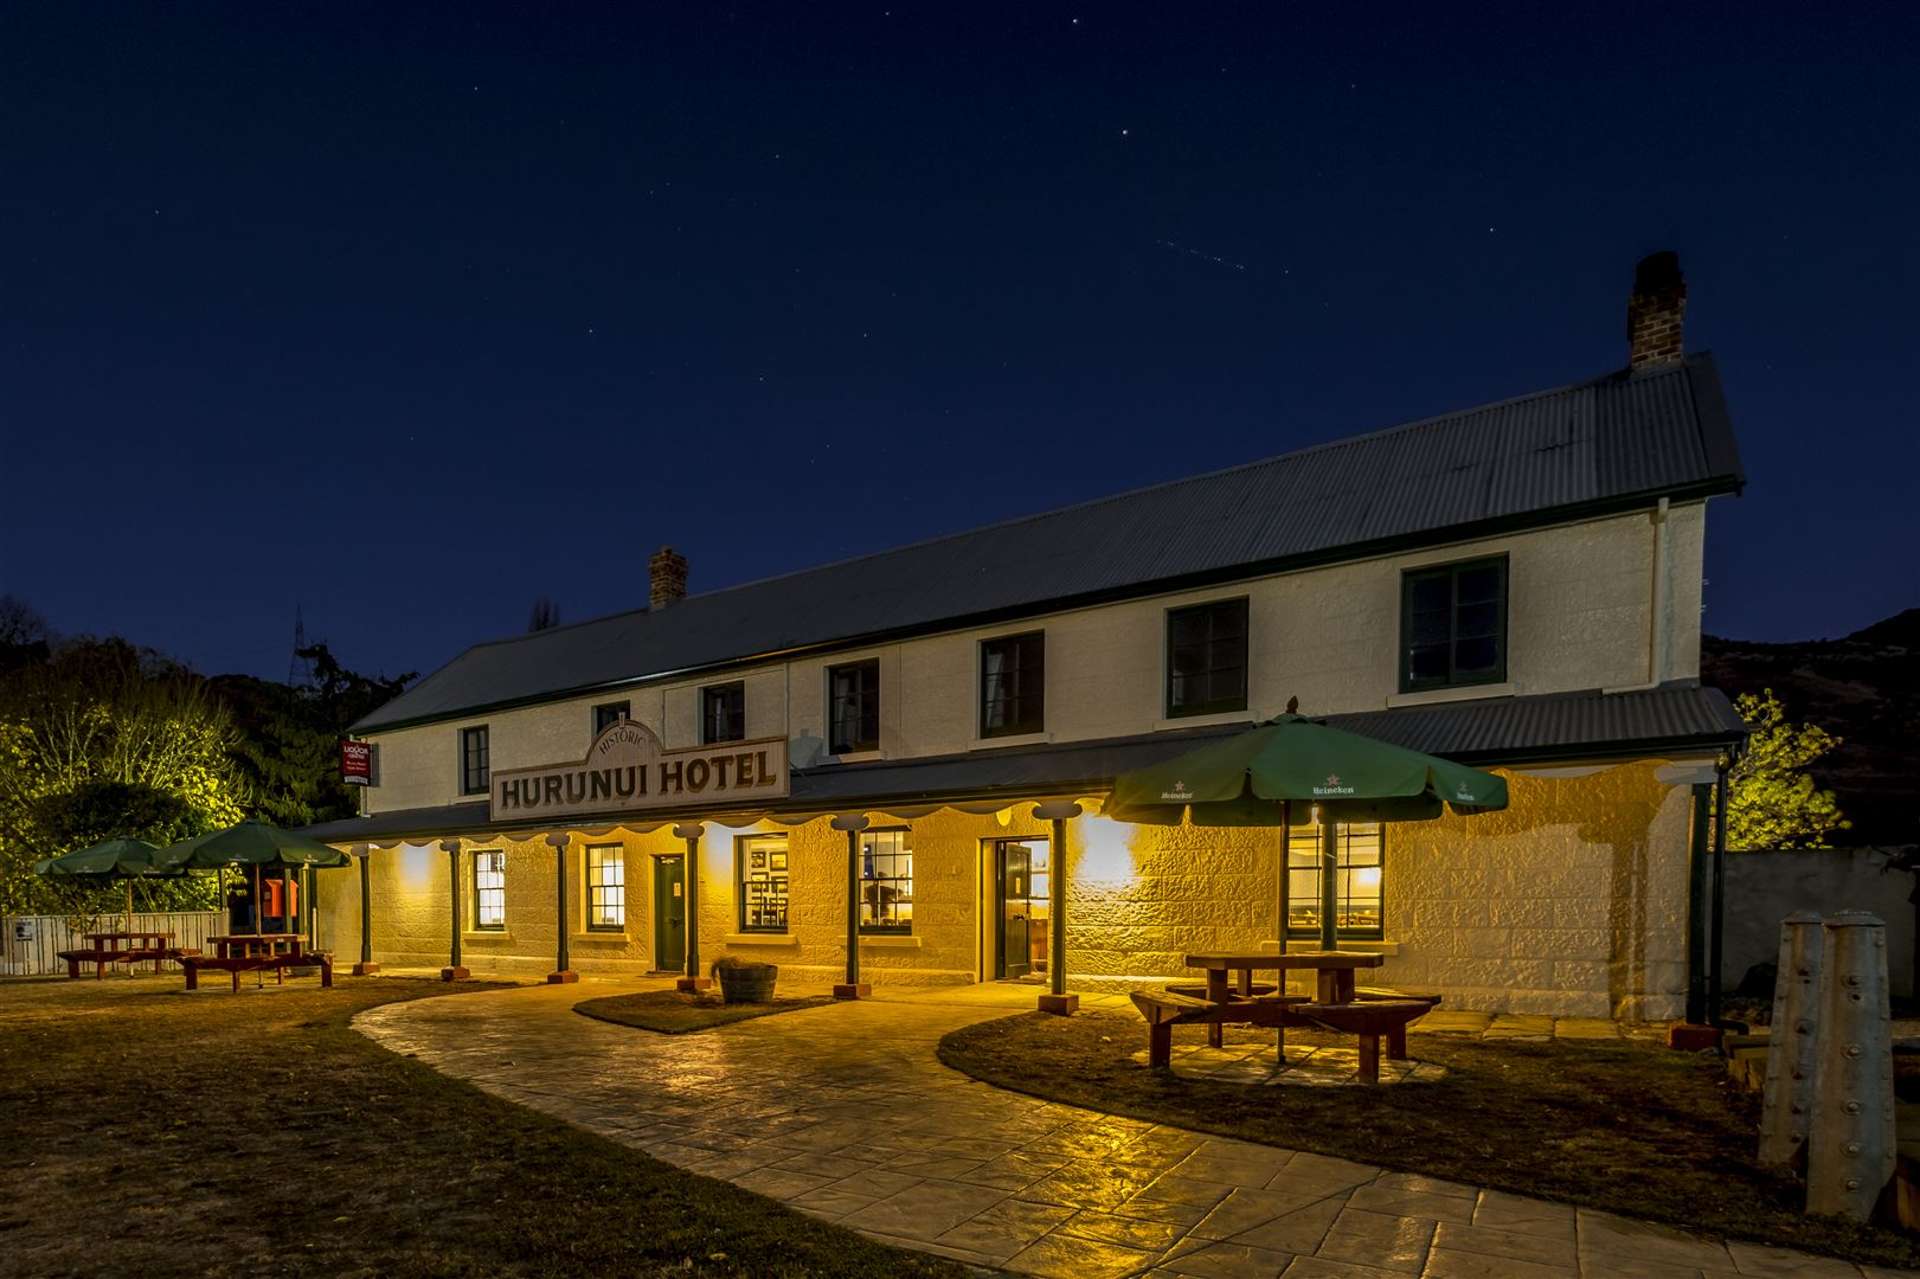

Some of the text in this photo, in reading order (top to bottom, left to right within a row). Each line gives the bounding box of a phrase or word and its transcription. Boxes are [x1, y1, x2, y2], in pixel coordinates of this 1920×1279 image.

[501, 751, 777, 810] HURUNUI HOTEL
[1313, 785, 1354, 795] Heineken
